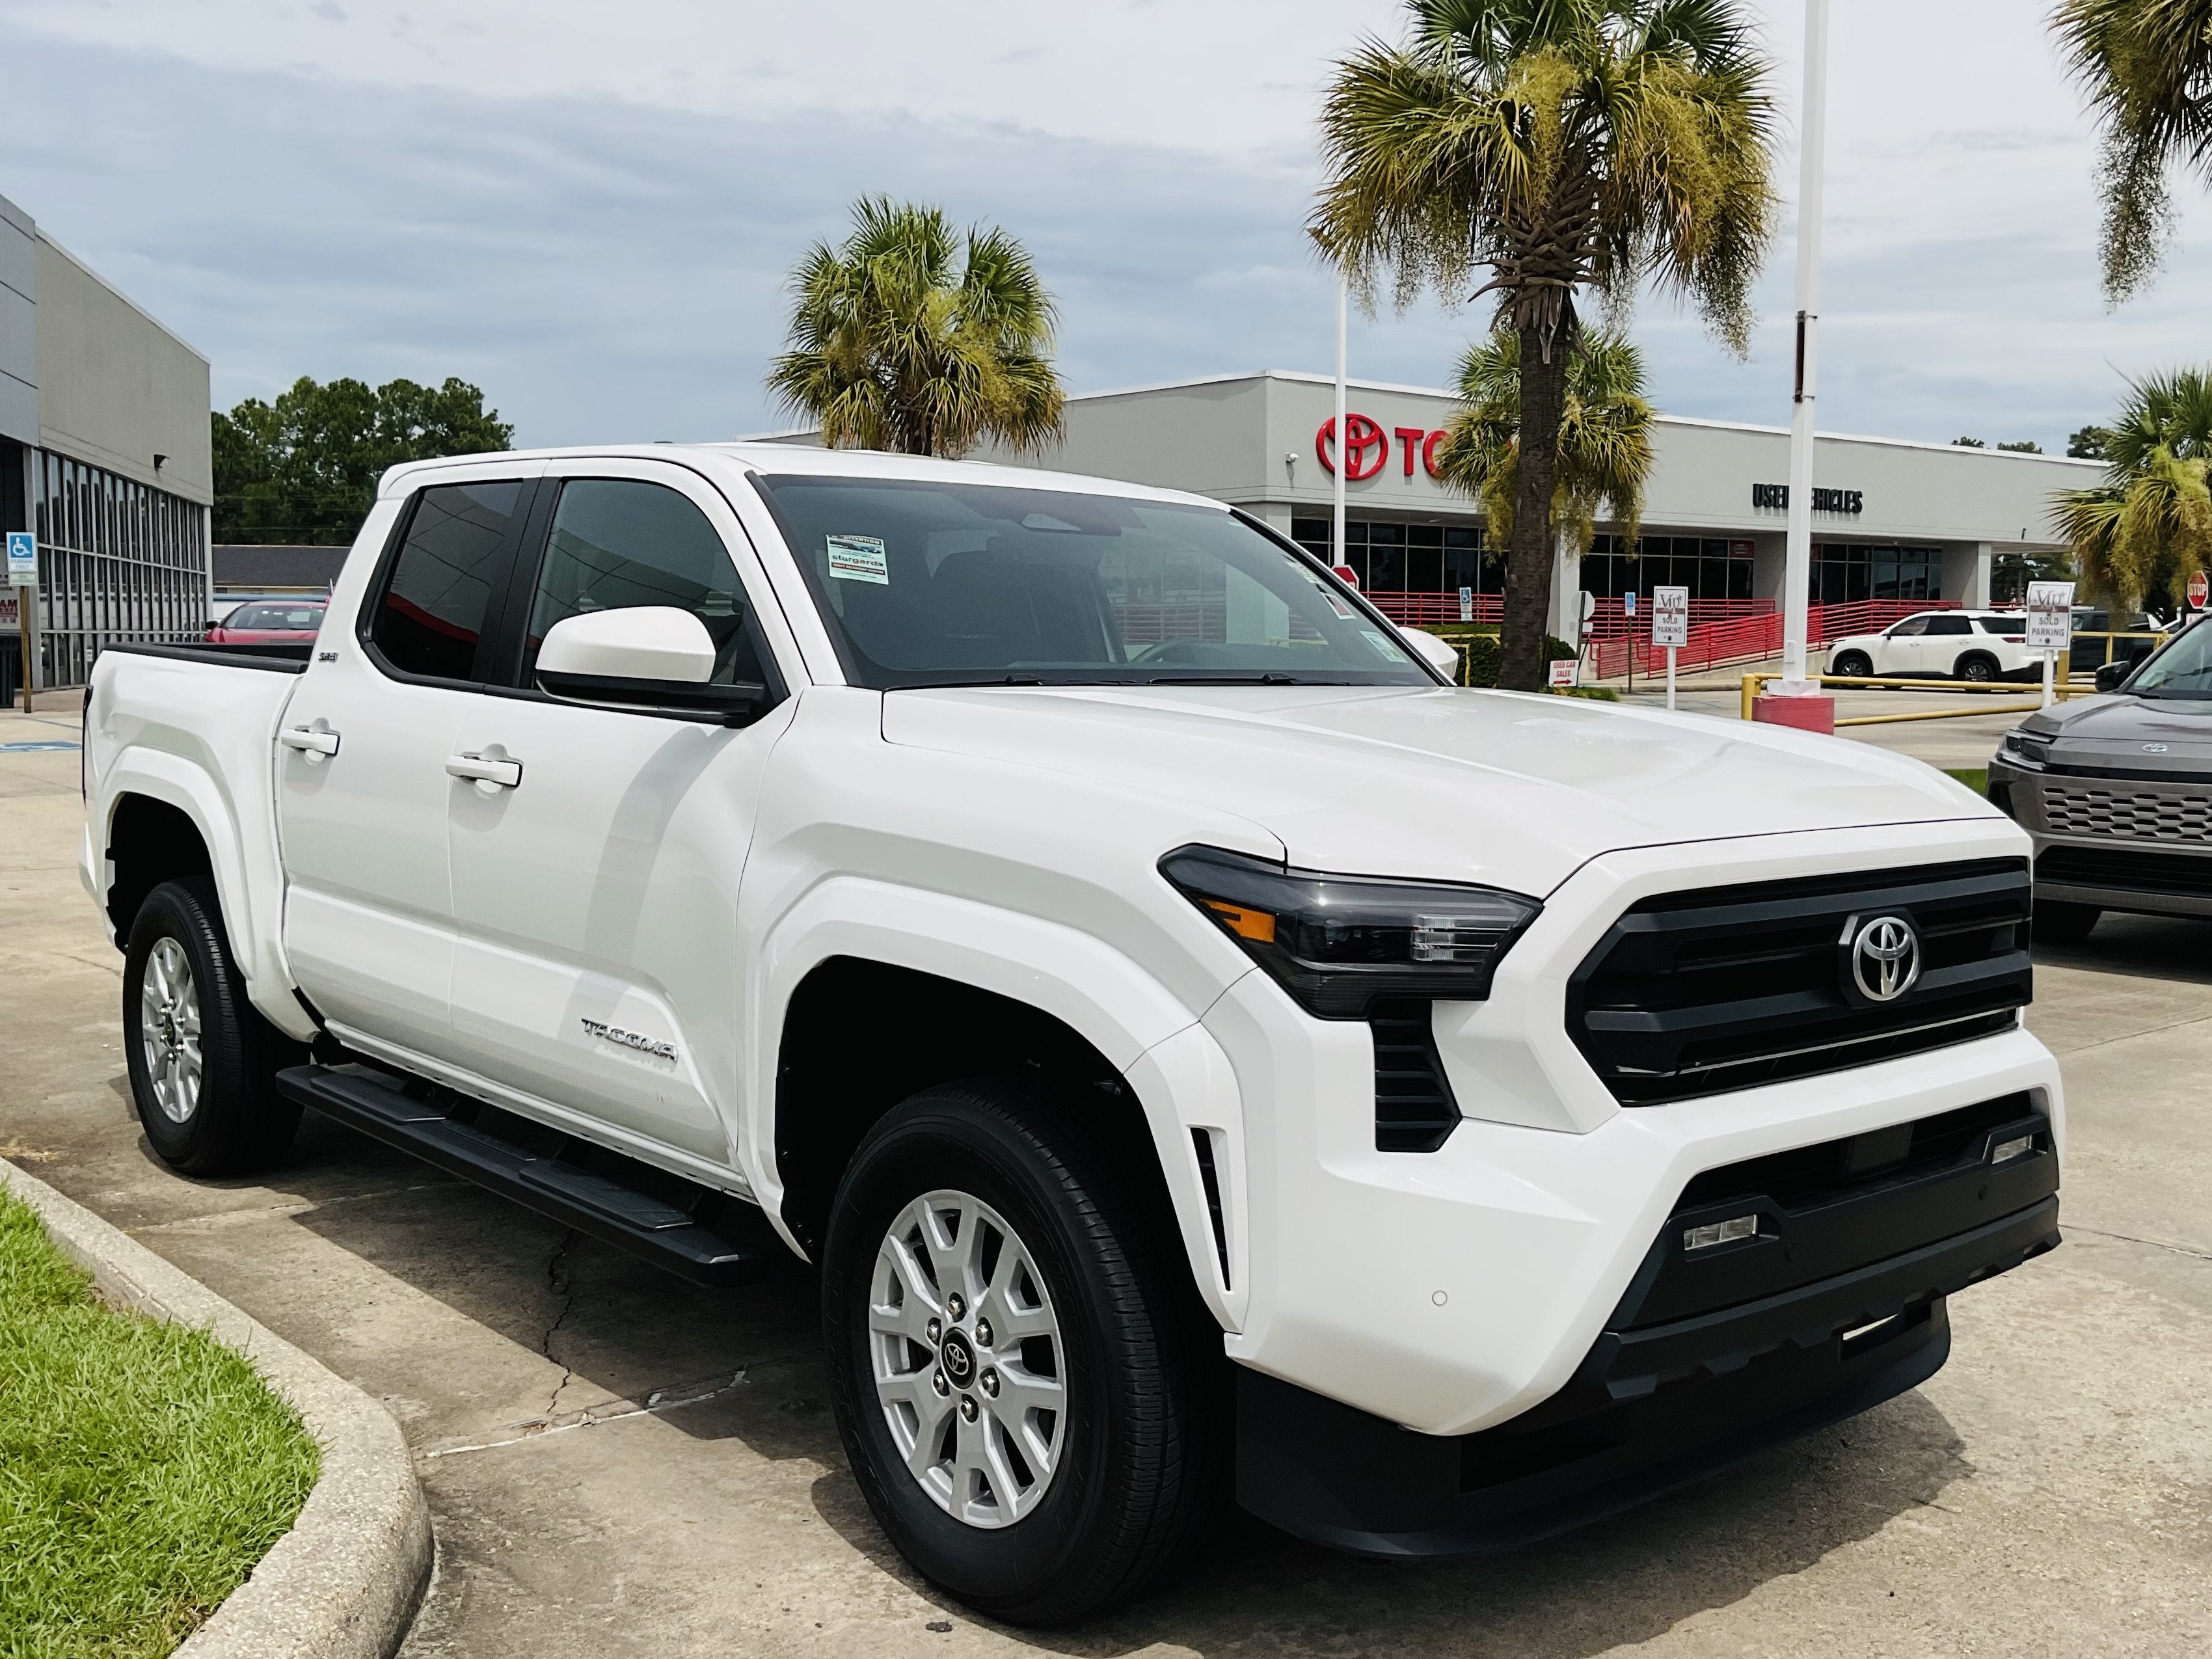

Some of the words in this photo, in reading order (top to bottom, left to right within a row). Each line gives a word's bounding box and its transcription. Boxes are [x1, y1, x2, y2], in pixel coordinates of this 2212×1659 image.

[843, 536, 880, 545] ATTENTION
[2189, 583, 2206, 597] STOP
[2039, 617, 2059, 625] SOLD
[2032, 628, 2064, 636] PARKING
[581, 1016, 679, 1063] TACOMA
